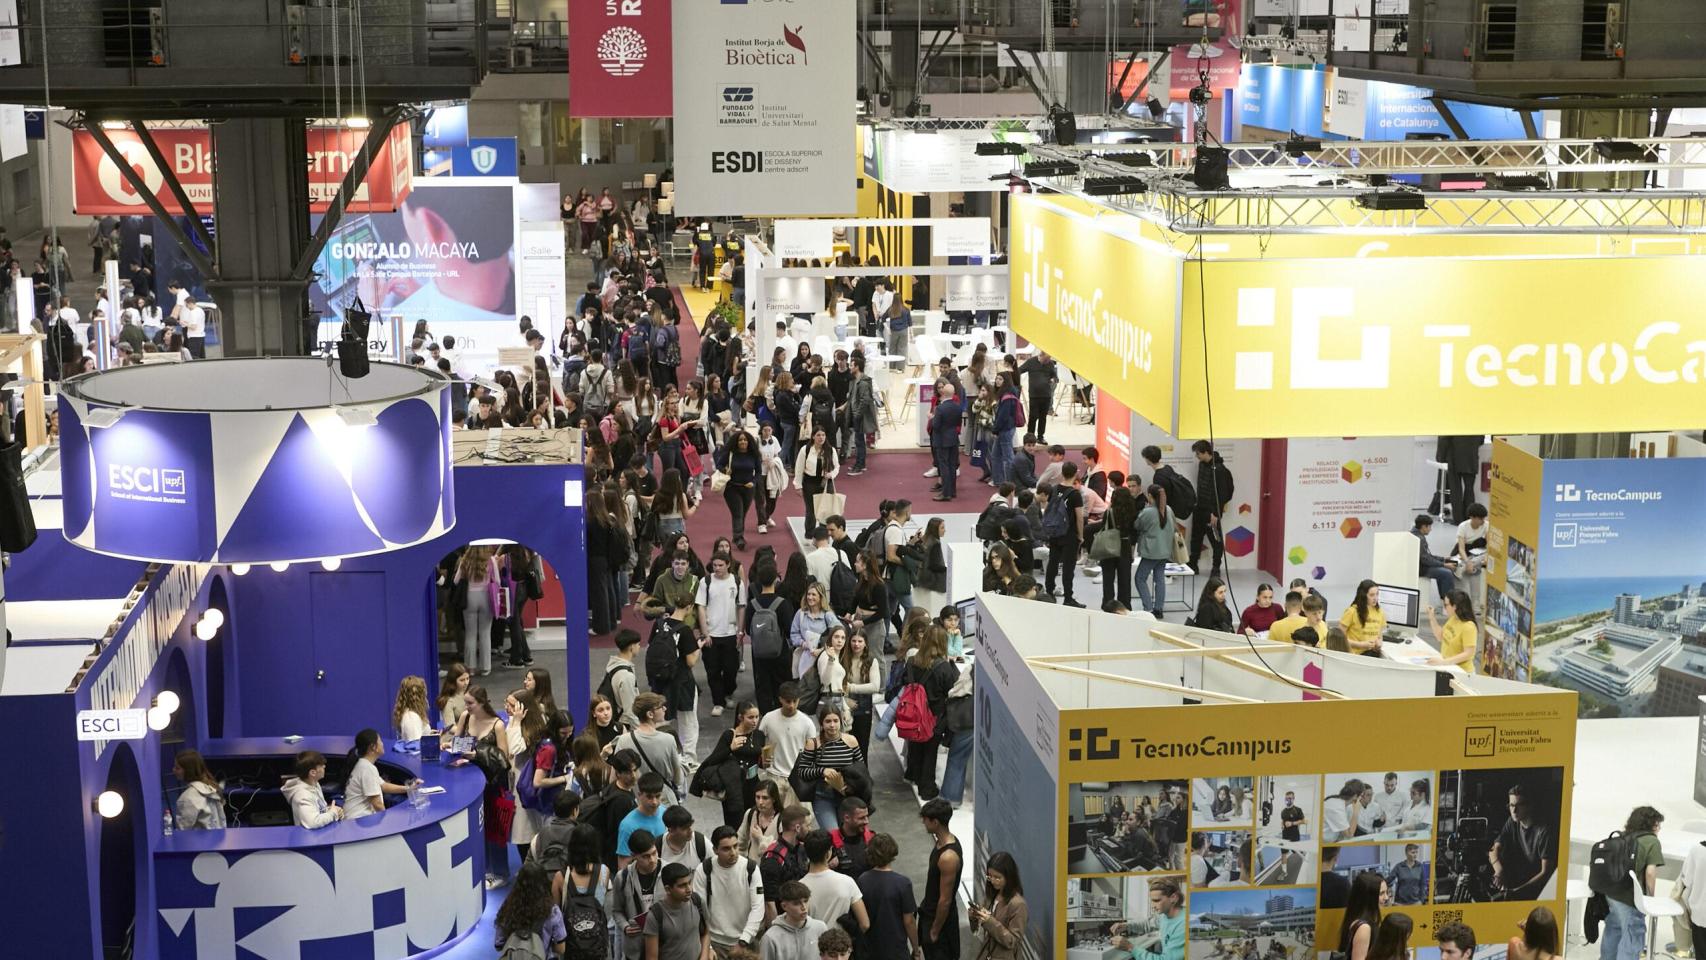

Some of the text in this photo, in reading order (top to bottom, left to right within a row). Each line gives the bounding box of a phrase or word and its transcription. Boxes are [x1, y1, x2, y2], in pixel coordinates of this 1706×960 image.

[754, 39, 775, 47] Borja
[726, 48, 795, 65] Bioètica
[1380, 117, 1439, 129] de Catalunya
[712, 151, 763, 173] ESDI
[331, 242, 480, 260] GONZALO MACAYA
[1053, 267, 1152, 380] TecnoCampus
[1424, 320, 1706, 388] TecnoCa
[109, 463, 159, 493] ESCI
[1365, 471, 1371, 479] 9
[1585, 489, 1662, 503] TecnoCampus
[984, 634, 1009, 687] TecnoCampus
[979, 687, 992, 739] 10
[82, 718, 120, 733] ESCI
[1130, 734, 1492, 761] TecnoCampus upf.
[1498, 745, 1536, 753] Barcelona
[1499, 736, 1552, 746] Pompeu Fabra
